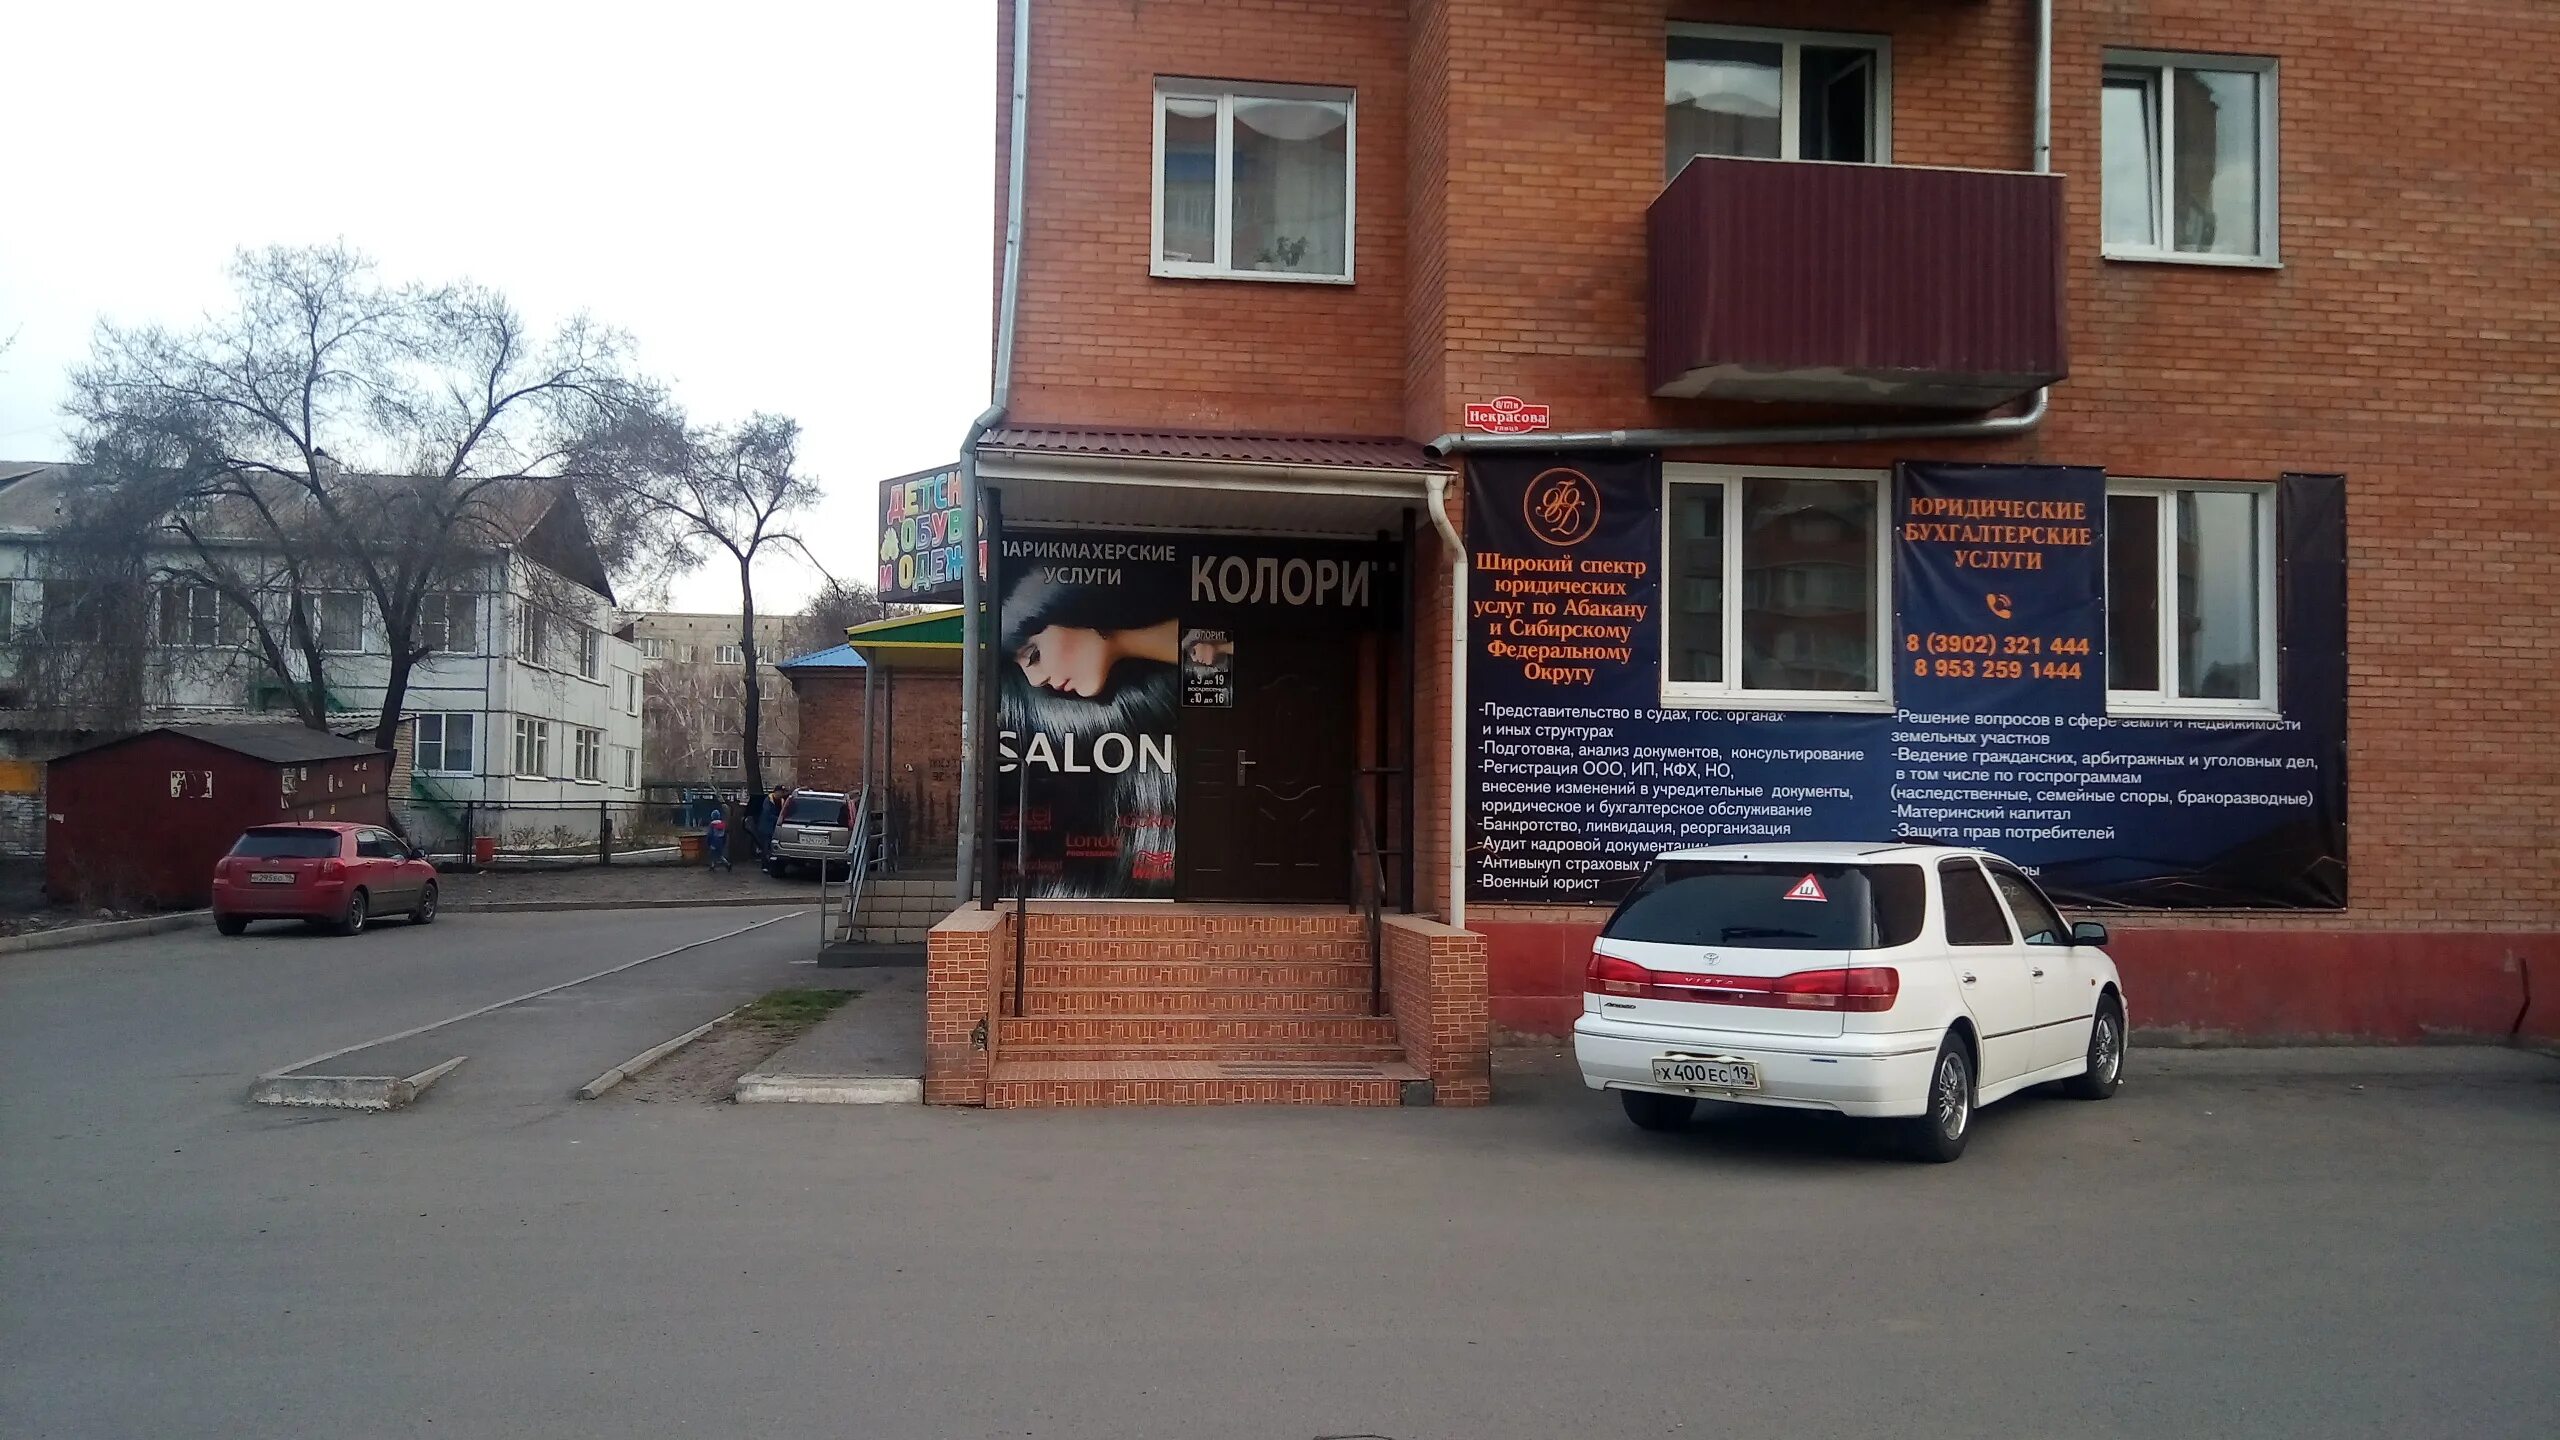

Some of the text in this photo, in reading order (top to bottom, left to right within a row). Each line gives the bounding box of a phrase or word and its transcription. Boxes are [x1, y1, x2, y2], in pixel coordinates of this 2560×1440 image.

[1470, 411, 1546, 425] Некрасова
[1911, 497, 2086, 520] ЮРИДИЧЕСКИЕ
[1904, 522, 2092, 546] БУХГАЛТЕРСКИЕ
[1476, 552, 1647, 579] Широкий спектр
[1954, 550, 2042, 570] УСЛУГИ
[880, 564, 892, 592] И
[1044, 567, 1121, 584] УСЛУГИ
[1191, 555, 1397, 607] КОЛОРИ
[1495, 579, 1627, 598] юридических
[1473, 598, 1648, 622] услуг по Абакану
[1489, 618, 1632, 644] и Сибирскому
[1487, 639, 1632, 665] Федеральному
[1906, 632, 2090, 657] 8 (3902) 321 444
[1215, 675, 1224, 685] 19
[1524, 661, 1595, 686] Округу
[1914, 658, 2082, 680] 8 953 259 1444
[1215, 693, 1224, 703] 16
[1478, 701, 1782, 725] -Представительство в судах, гос. органах
[1891, 708, 1970, 725] -Решение
[1974, 714, 2051, 729] вопросов
[2054, 716, 2064, 727] в
[2068, 713, 2116, 733] сфере
[1482, 725, 1614, 742] и иных структурах
[1890, 731, 2050, 748] земельных участков
[1000, 731, 1172, 773] SALON
[1477, 739, 1865, 764] -Подготовка, анализ документов, консультирование
[1890, 746, 2318, 770] -Ведение гражданских, арбитражных и уголовных дел,
[1477, 758, 1734, 780] -Регистрация ООО, ИП, КФХ, НО,
[1895, 769, 2142, 787] в том числе по госпрограммам
[1482, 781, 1854, 802] внесение изменений в учредительные документы,
[1890, 783, 2314, 808] (наследственные, семейные споры, бракоразводные)
[1481, 799, 1813, 820] юридическое и бухгалтерское обслуживание
[1890, 803, 2071, 822] -Материнский капитал
[1477, 816, 1791, 838] -Банкротство, ликвидация, реорганизация
[1890, 822, 2115, 842] -Защита прав потребителей
[1476, 835, 1527, 854] -Аудит
[1531, 837, 1601, 854] кадровой
[1476, 854, 1561, 874] -Антивыкуп
[1565, 859, 1640, 874] страховых
[1476, 873, 1600, 893] -Военный юрист
[1733, 1066, 1748, 1079] 19
